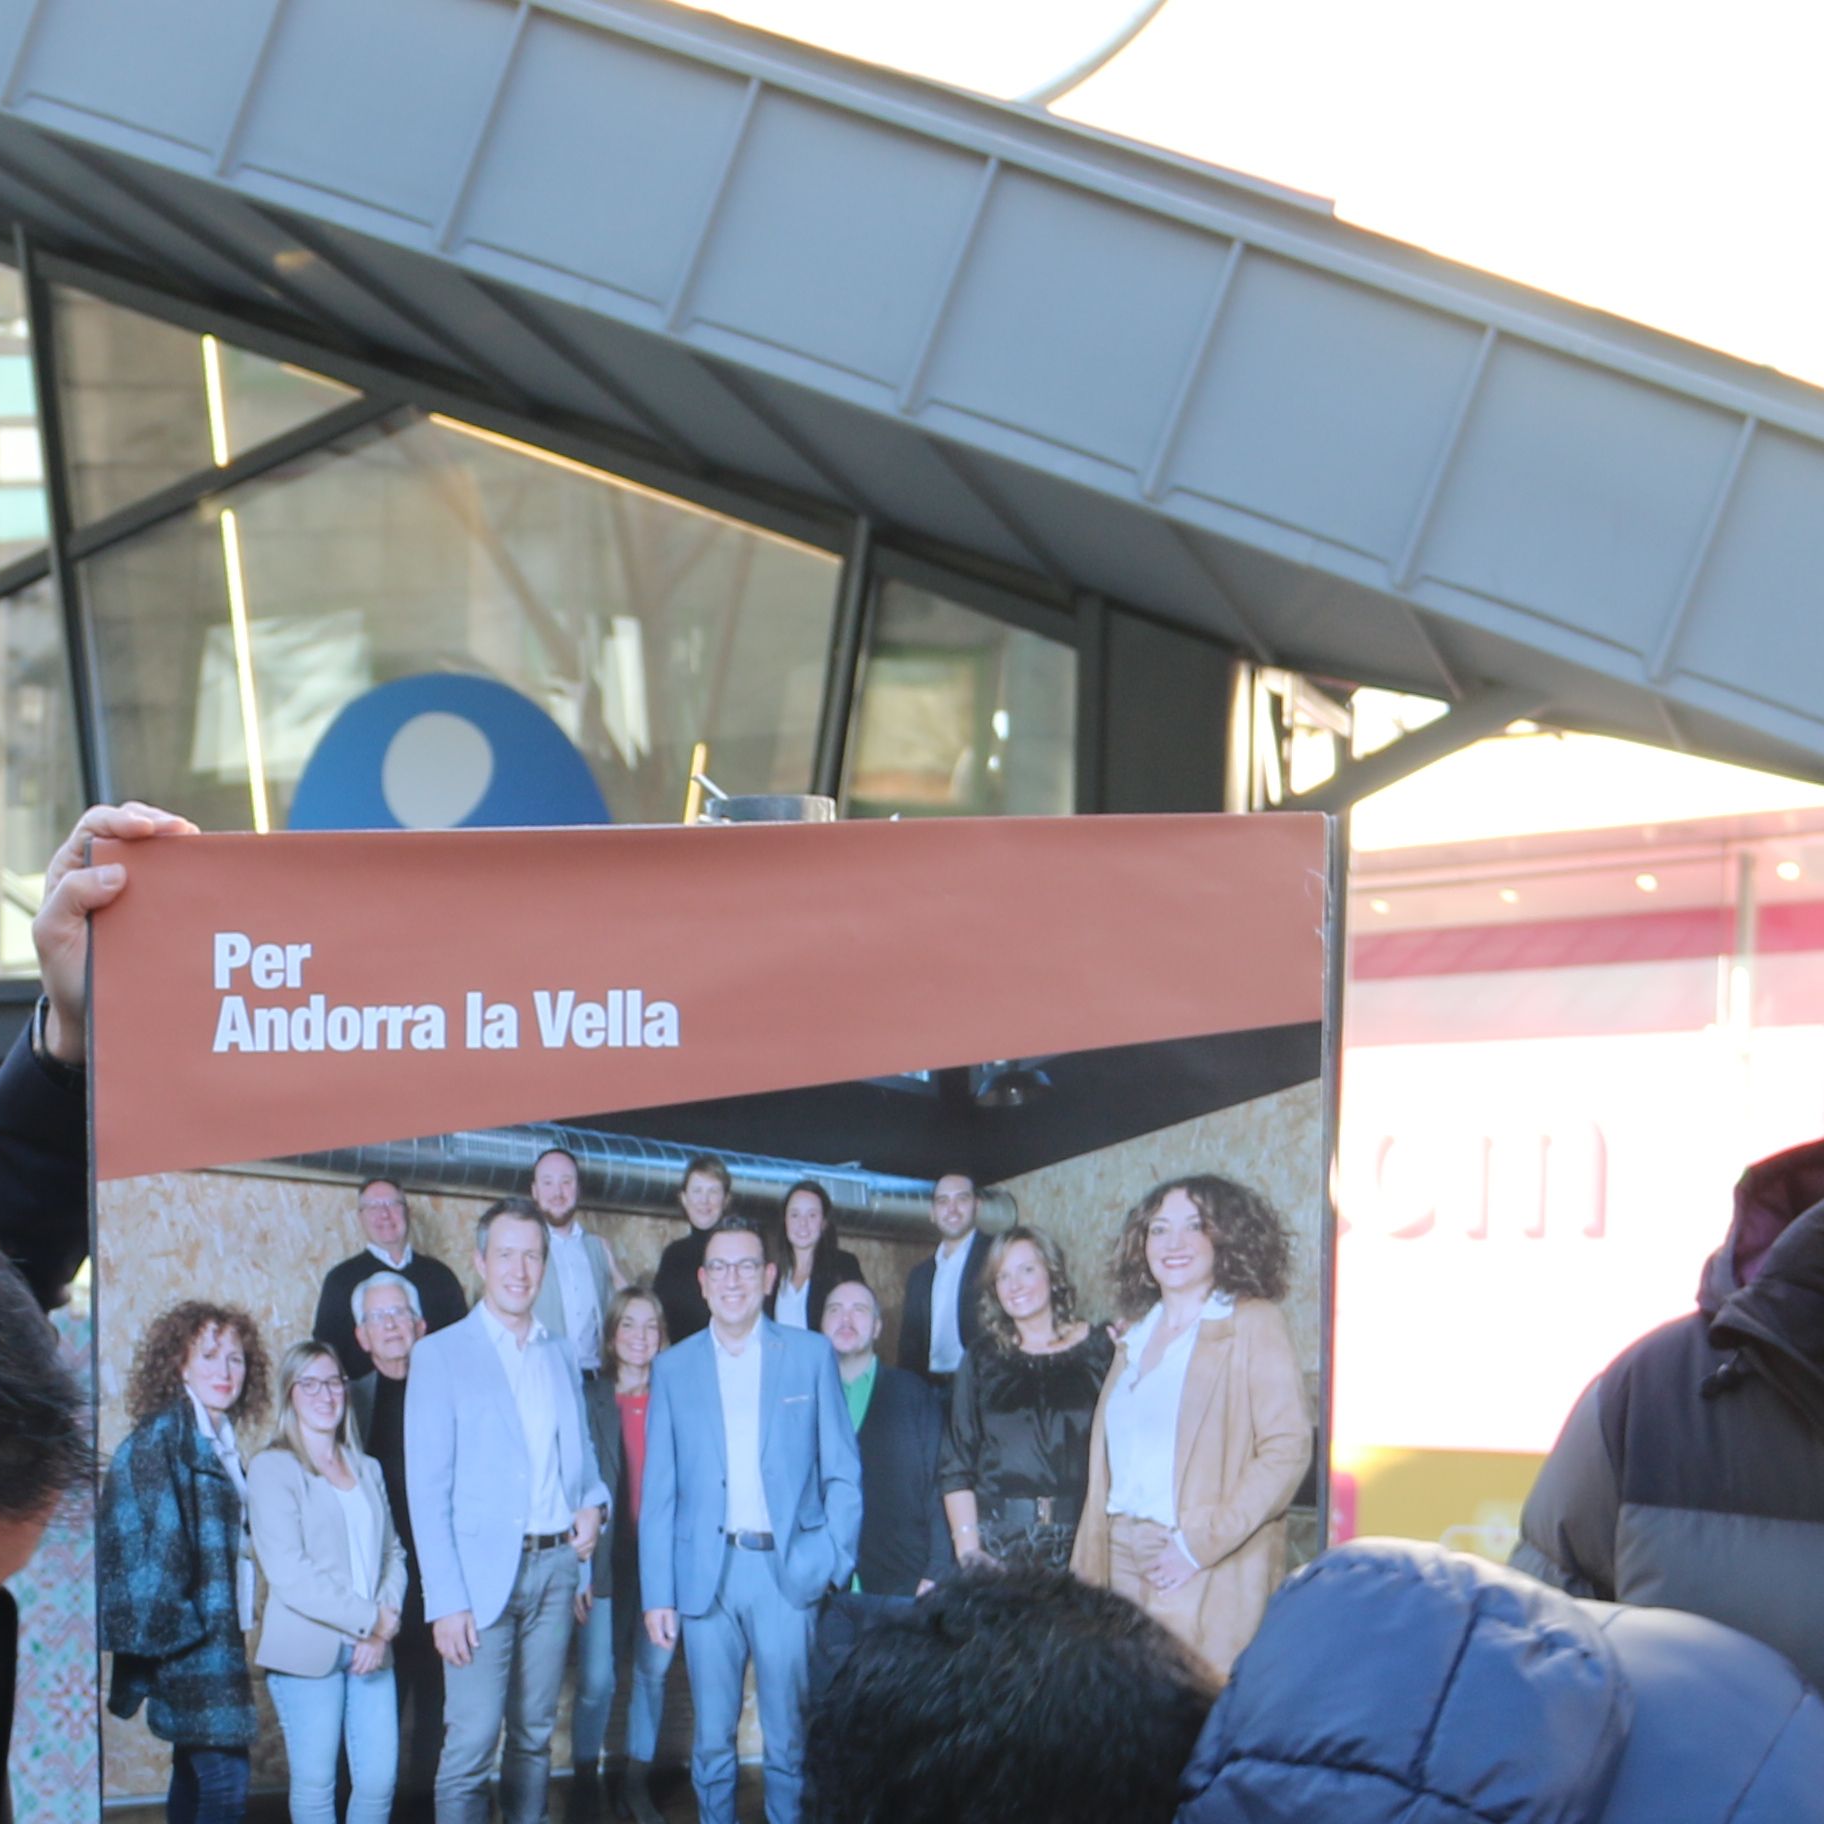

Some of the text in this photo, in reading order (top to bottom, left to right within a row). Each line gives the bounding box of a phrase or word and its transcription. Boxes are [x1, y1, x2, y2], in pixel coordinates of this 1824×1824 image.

[213, 932, 311, 989] Per
[213, 989, 680, 1052] Andorra la Vella
